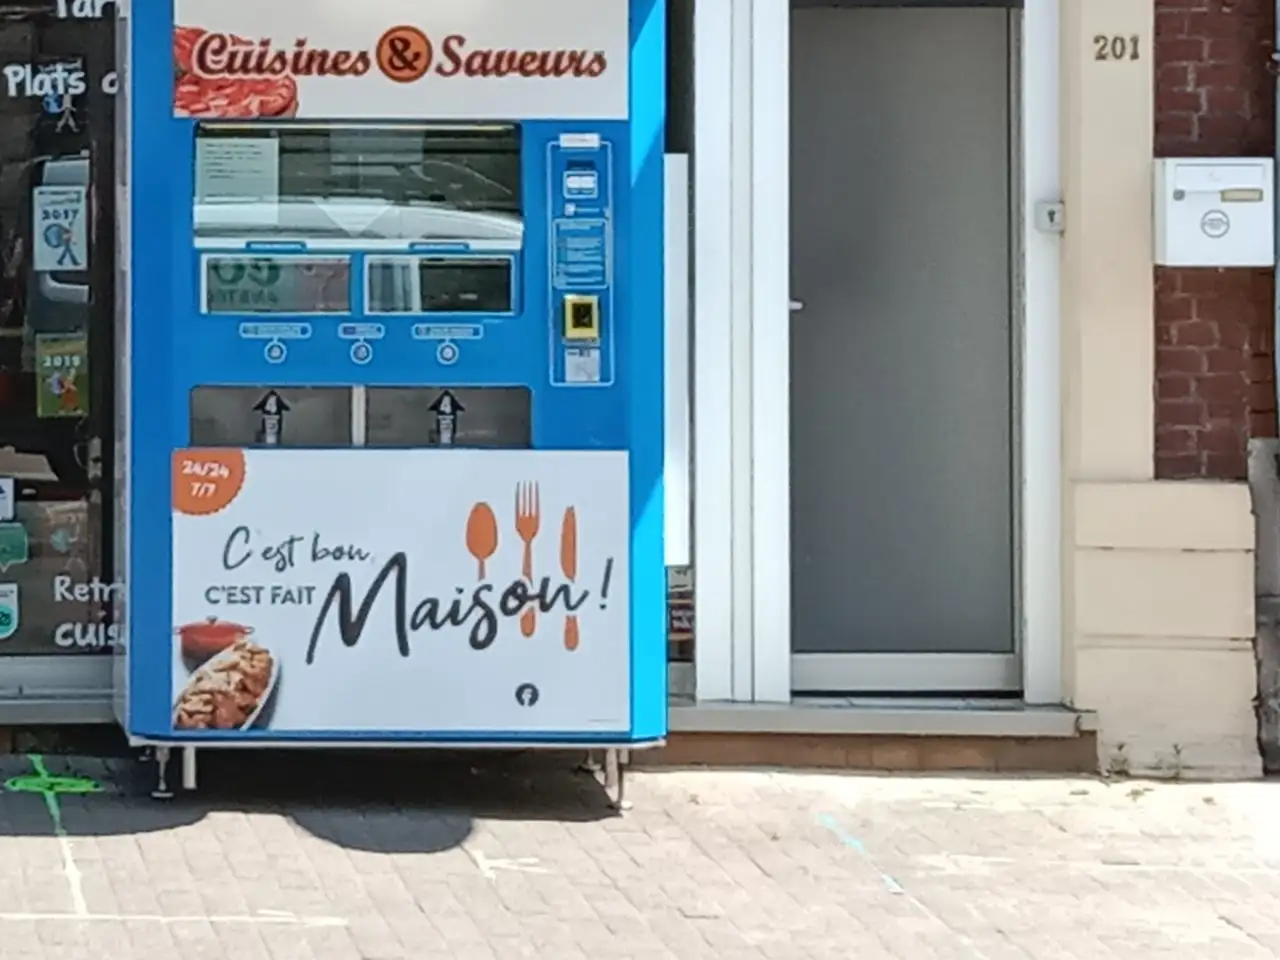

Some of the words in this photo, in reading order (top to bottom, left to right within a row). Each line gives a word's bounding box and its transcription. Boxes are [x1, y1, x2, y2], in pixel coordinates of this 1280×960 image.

[196, 32, 372, 77] Cuisines
[387, 37, 421, 73] &
[435, 35, 607, 77] Saveurs
[1092, 35, 1140, 61] 201
[3, 63, 87, 97] Plats
[182, 459, 230, 479] 24/24
[190, 481, 217, 498] 7/7
[223, 525, 304, 573] C'est
[54, 575, 124, 602] Retr
[204, 585, 265, 605] C'EST
[271, 585, 317, 605] FAIT
[54, 621, 122, 648] cuis
